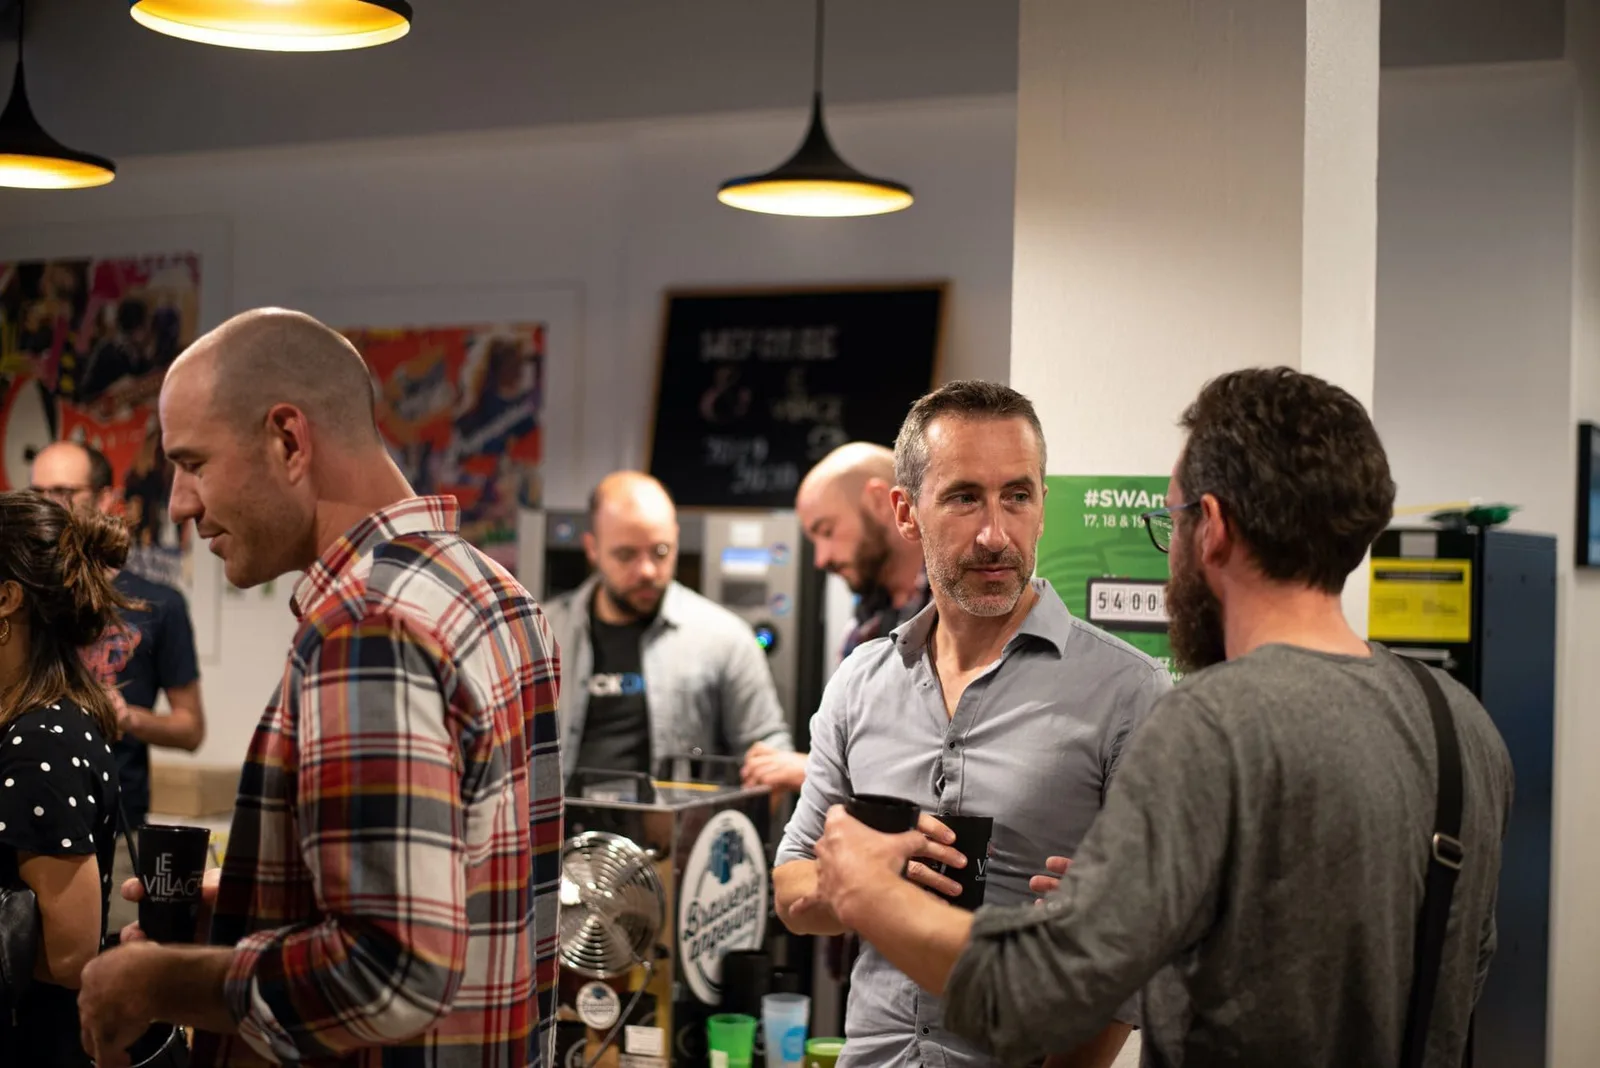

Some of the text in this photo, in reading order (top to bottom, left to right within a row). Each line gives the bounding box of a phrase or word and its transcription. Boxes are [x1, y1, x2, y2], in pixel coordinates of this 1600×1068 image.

[1084, 488, 1165, 508] #SWAn
[1083, 513, 1099, 529] 17,
[1102, 514, 1117, 528] 18
[1119, 514, 1128, 528] &
[155, 853, 173, 876] LE
[143, 872, 203, 897] VILLAG
